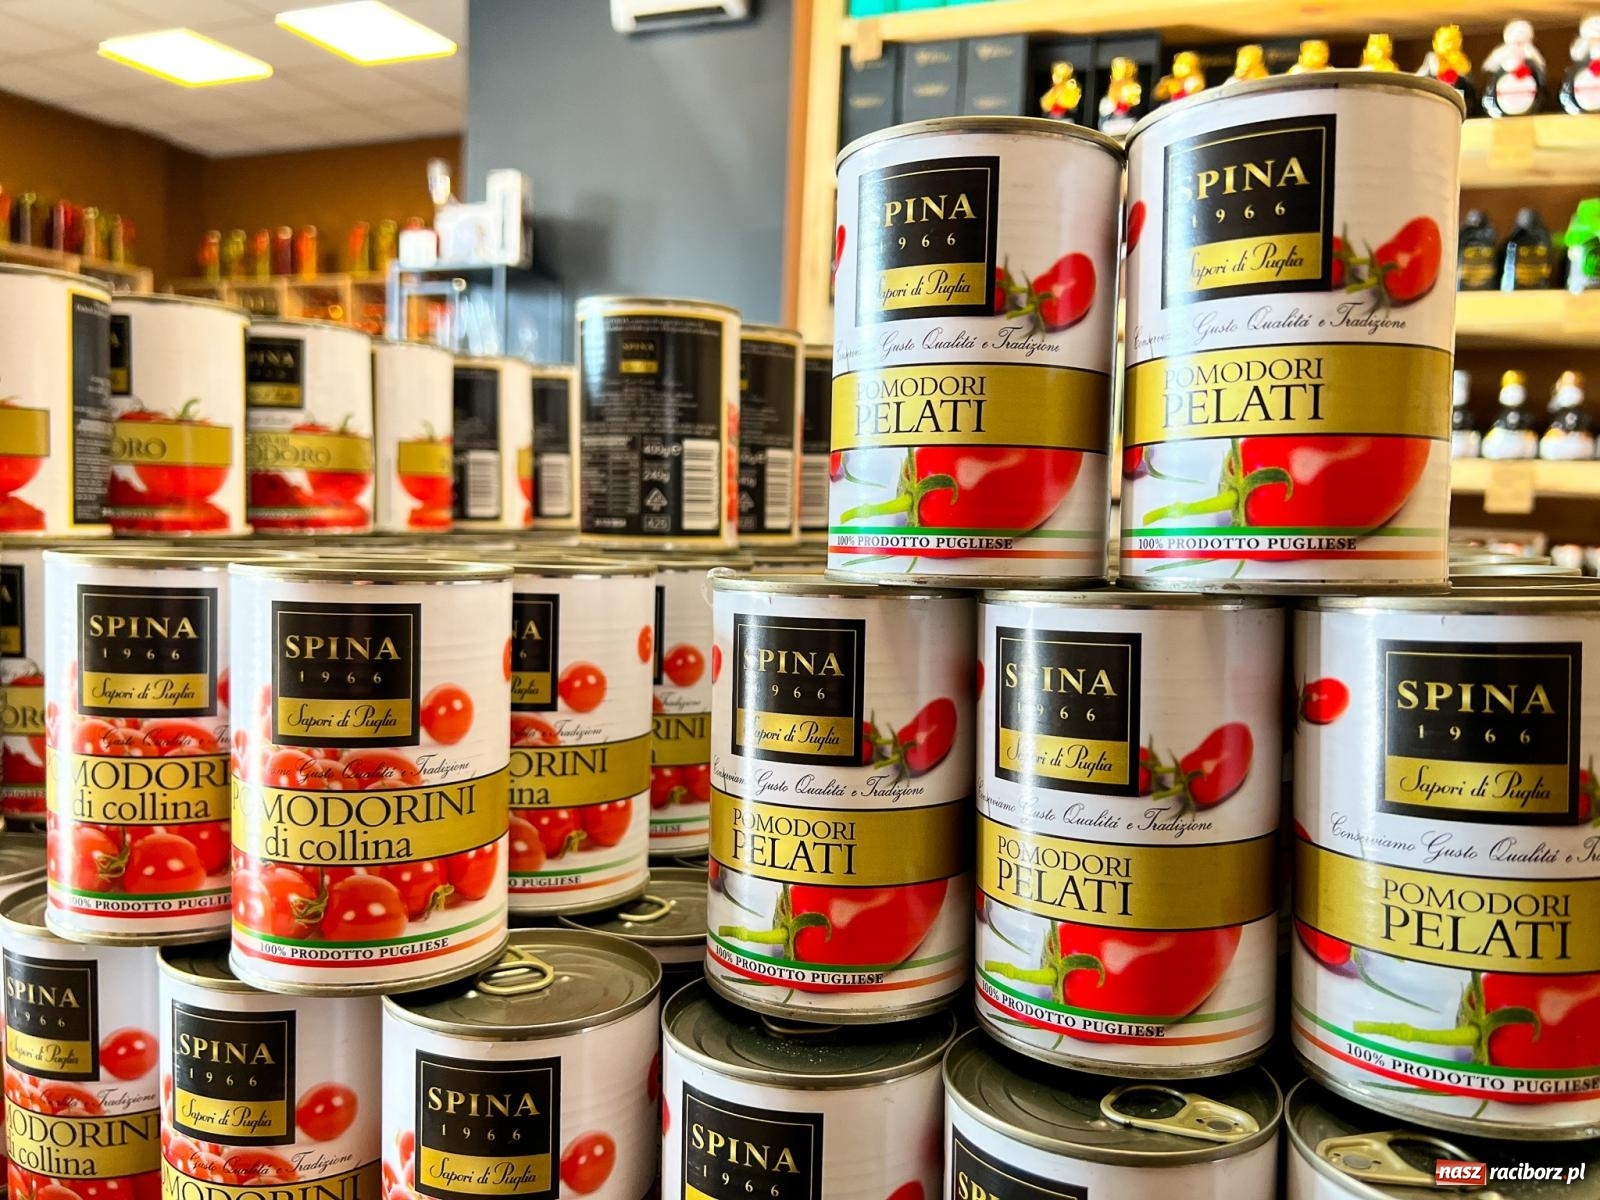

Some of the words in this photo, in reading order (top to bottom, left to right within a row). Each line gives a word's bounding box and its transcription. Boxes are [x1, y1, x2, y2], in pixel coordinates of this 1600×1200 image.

[884, 192, 977, 229] PINA
[898, 231, 956, 251] 966
[1232, 249, 1248, 273] di
[1251, 242, 1304, 277] Puglia
[911, 274, 924, 297] di
[925, 269, 970, 302] Puglia
[1192, 311, 1238, 345] Gusto
[1318, 319, 1326, 328] e
[1329, 302, 1407, 335] Tradizione
[880, 325, 915, 358] Gusto
[981, 341, 989, 349] e
[992, 326, 1060, 358] Tradizione
[857, 375, 987, 400] POMODORI
[1164, 357, 1324, 390] POMODORI
[855, 399, 987, 437] PELATI
[1162, 383, 1325, 429] PELATI
[837, 534, 855, 546] 100%
[857, 536, 930, 548] PRODOTTO
[935, 537, 1013, 550] PUGLIESE
[1138, 537, 1163, 550] 100%
[1167, 538, 1260, 551] PRODOTTO
[1267, 538, 1357, 551] PUGLIESE
[89, 614, 199, 639] SPINA
[103, 647, 180, 660] 1966
[285, 634, 401, 660] SPINA
[91, 677, 135, 704] Sapori
[137, 684, 150, 700] di
[152, 678, 196, 706] Puglia
[299, 671, 382, 684] 1966
[1397, 679, 1556, 715] SPINA
[287, 703, 334, 733] Sapori
[337, 712, 351, 728] di
[353, 704, 398, 734] Puglia
[1417, 724, 1531, 744] 1966
[784, 722, 795, 742] di
[798, 719, 840, 752] Puglia
[298, 758, 334, 783] Gusto
[410, 753, 471, 780] Tradizione
[1050, 747, 1063, 767] di
[1065, 744, 1113, 778] Puglia
[713, 753, 746, 785] Conserviam
[756, 769, 788, 796] Gusto
[851, 788, 858, 797] e
[861, 775, 924, 803] Tradizione
[1399, 764, 1463, 800] Sapori
[1470, 774, 1486, 797] di
[1491, 769, 1552, 808] Puglia
[72, 789, 93, 818] di
[102, 792, 210, 821] collina
[733, 808, 856, 841] POMODORI
[1126, 821, 1134, 830] e
[1137, 807, 1214, 838] Tradizione
[1330, 811, 1416, 852] Conserviamo
[1420, 830, 1478, 863] Gusto
[1565, 854, 1574, 863] e
[265, 826, 289, 858] di
[299, 829, 413, 861] collina
[731, 828, 857, 875] PELATI
[998, 835, 1133, 878] POMODORI
[522, 875, 582, 888] PUGLIESE
[996, 857, 1133, 917] PELATI
[1382, 878, 1571, 918] POMODORI
[71, 897, 92, 909] 00%
[95, 899, 172, 912] PRODOTTO
[1380, 902, 1572, 960] PELATI
[260, 942, 287, 957] 100%
[290, 947, 373, 960] PRODOTTO
[379, 937, 449, 958] PUGLIESE
[715, 944, 733, 963] 100%
[735, 957, 806, 982] PRODOTTO
[811, 972, 884, 985] PUGLIESE
[7, 975, 80, 1009] SPINA
[13, 1009, 66, 1028] 1966
[982, 980, 1000, 1001] 100%
[1001, 993, 1077, 1028] PRODOTTO
[1082, 1018, 1165, 1038] PUGLIESE
[45, 1043, 80, 1070] Puglia
[179, 1033, 276, 1065] SPINA
[189, 1067, 257, 1087] 1966
[1346, 1042, 1385, 1067] 100%
[1391, 1058, 1505, 1092] PRODOTTO
[1512, 1076, 1600, 1094] PUGLIESE
[96, 1088, 157, 1110] Tradizione
[182, 1098, 217, 1124] Sapori
[218, 1107, 228, 1126] di
[231, 1105, 273, 1133] Puglia
[427, 1086, 541, 1119] SPINA
[441, 1123, 521, 1142] 1966
[691, 1122, 801, 1174] SPINA
[18, 1145, 98, 1176] collina
[285, 1149, 353, 1174] Tradizione
[429, 1157, 475, 1187] Sapori
[477, 1168, 488, 1185] di
[492, 1161, 537, 1192] Puglia
[703, 1164, 780, 1198] 1966
